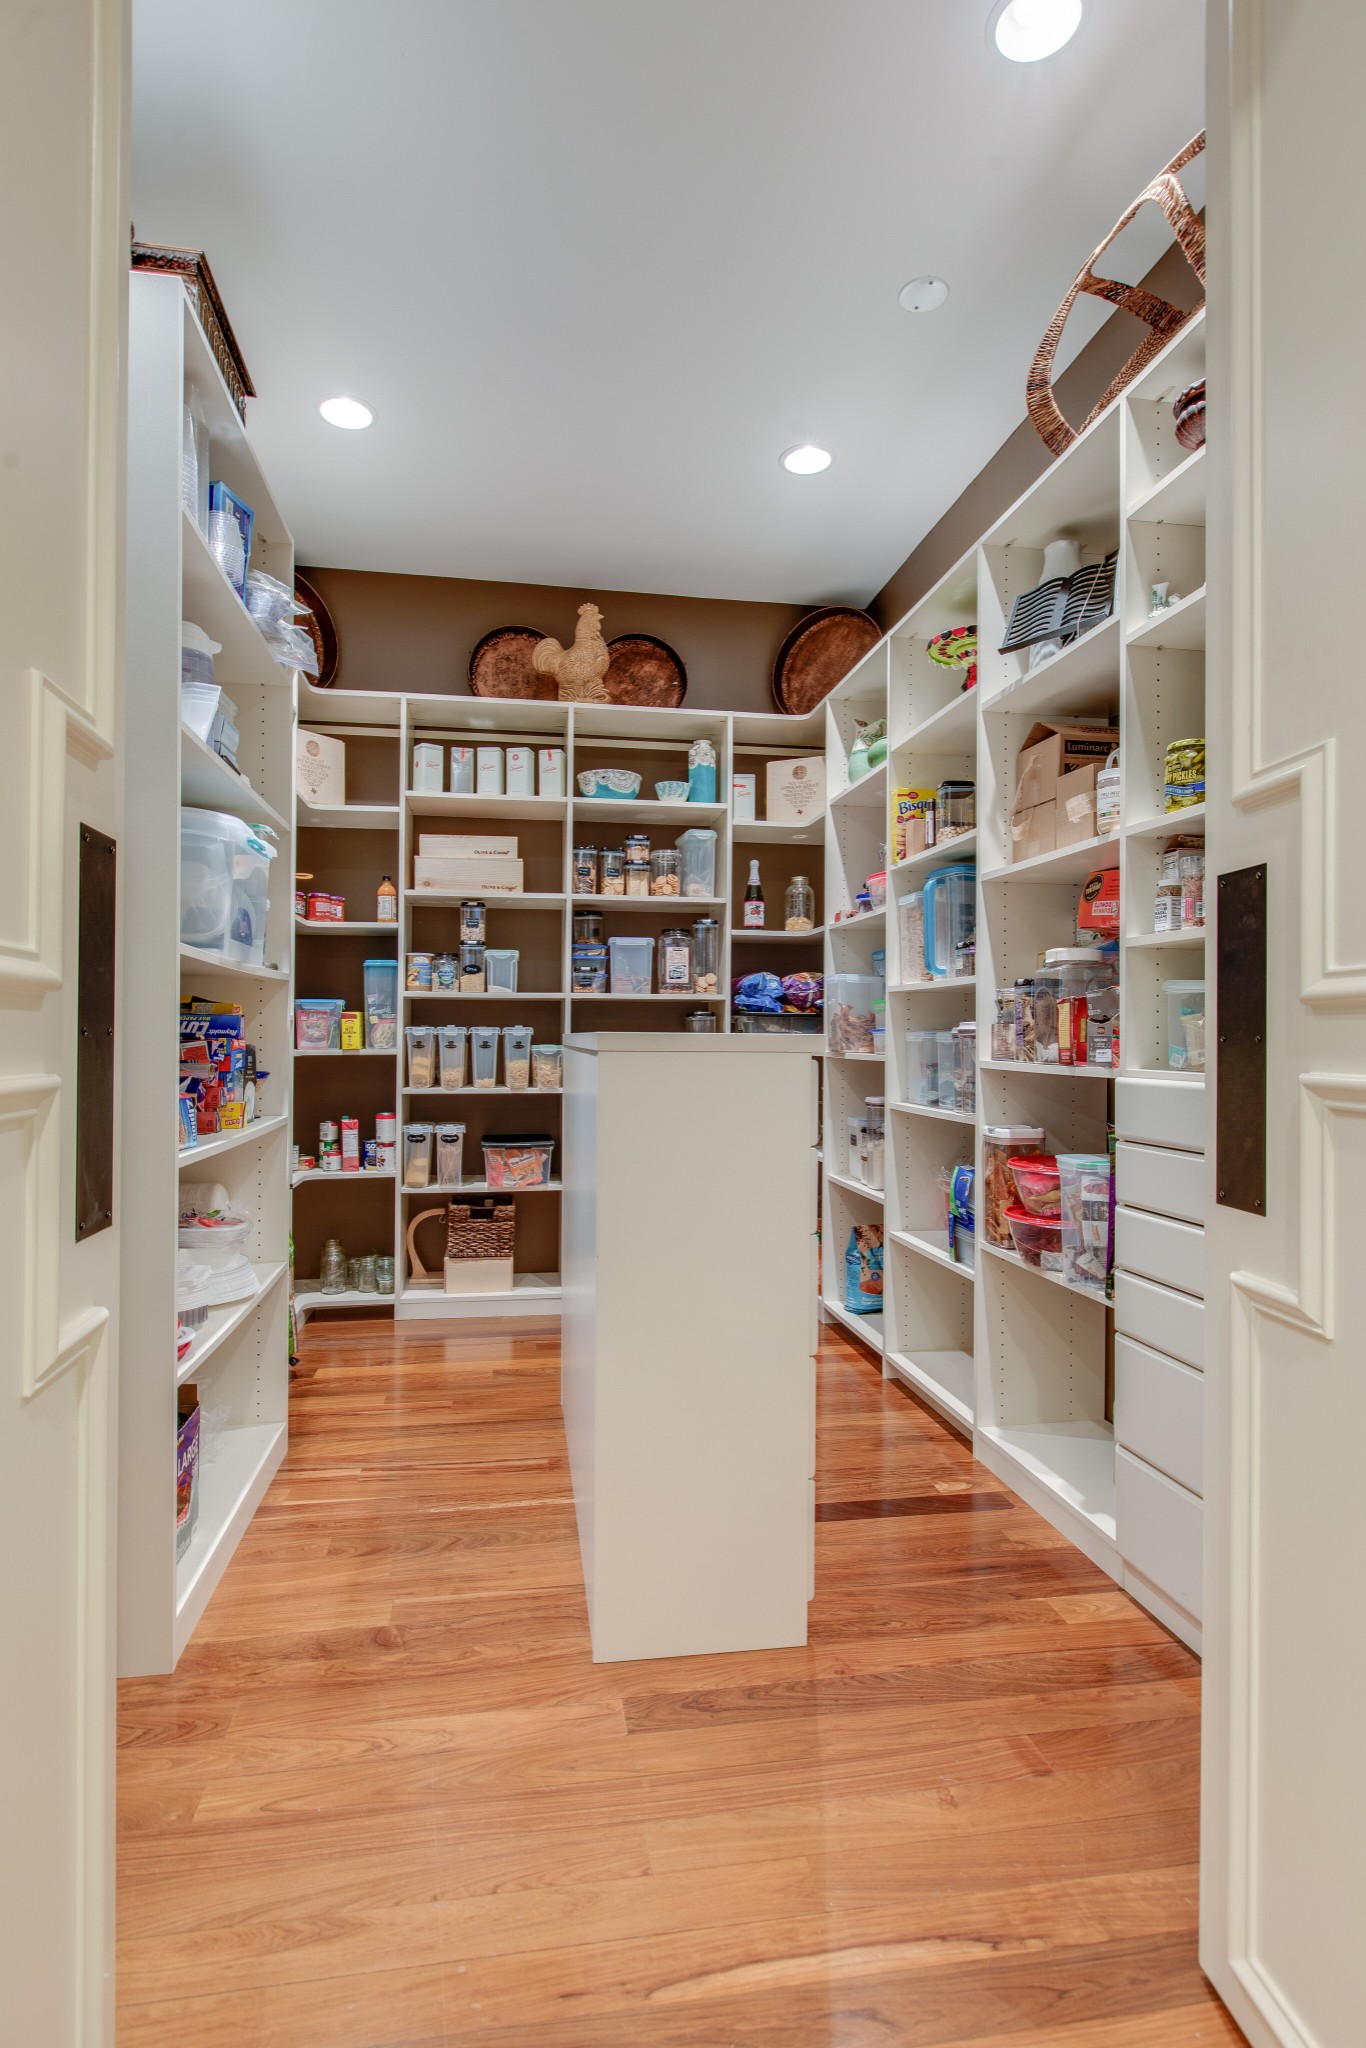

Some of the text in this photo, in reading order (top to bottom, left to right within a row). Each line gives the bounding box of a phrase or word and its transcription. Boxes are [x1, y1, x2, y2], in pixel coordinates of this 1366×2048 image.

[1067, 742, 1109, 753] Luminarc
[1173, 769, 1197, 781] PICKLES
[898, 800, 928, 815] Bisq
[208, 1028, 238, 1036] Reynolds
